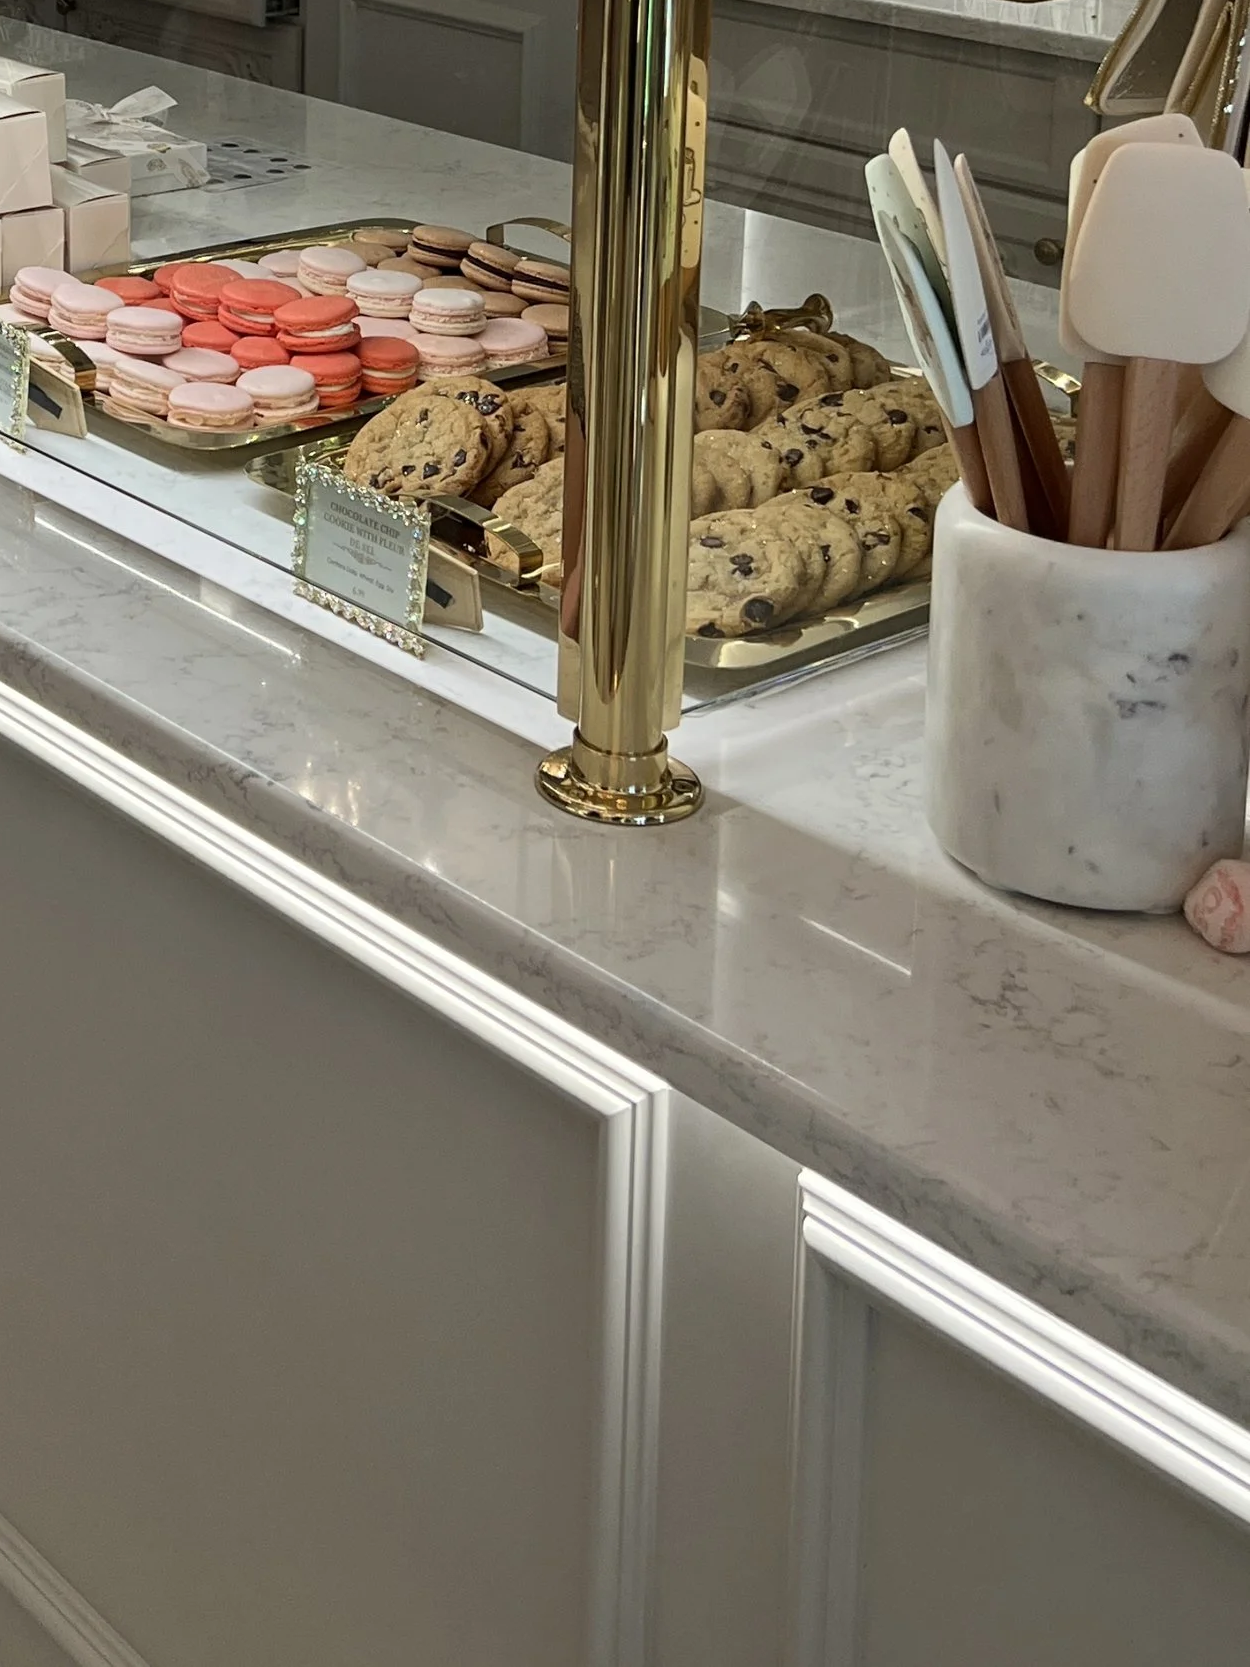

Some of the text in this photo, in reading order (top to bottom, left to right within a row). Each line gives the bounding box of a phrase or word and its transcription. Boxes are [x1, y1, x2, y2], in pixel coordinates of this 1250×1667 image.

[324, 511, 355, 534] COOKIE
[356, 526, 378, 543] WITH
[331, 502, 400, 539] CHOCOLATE CHIP
[349, 537, 361, 549] DE
